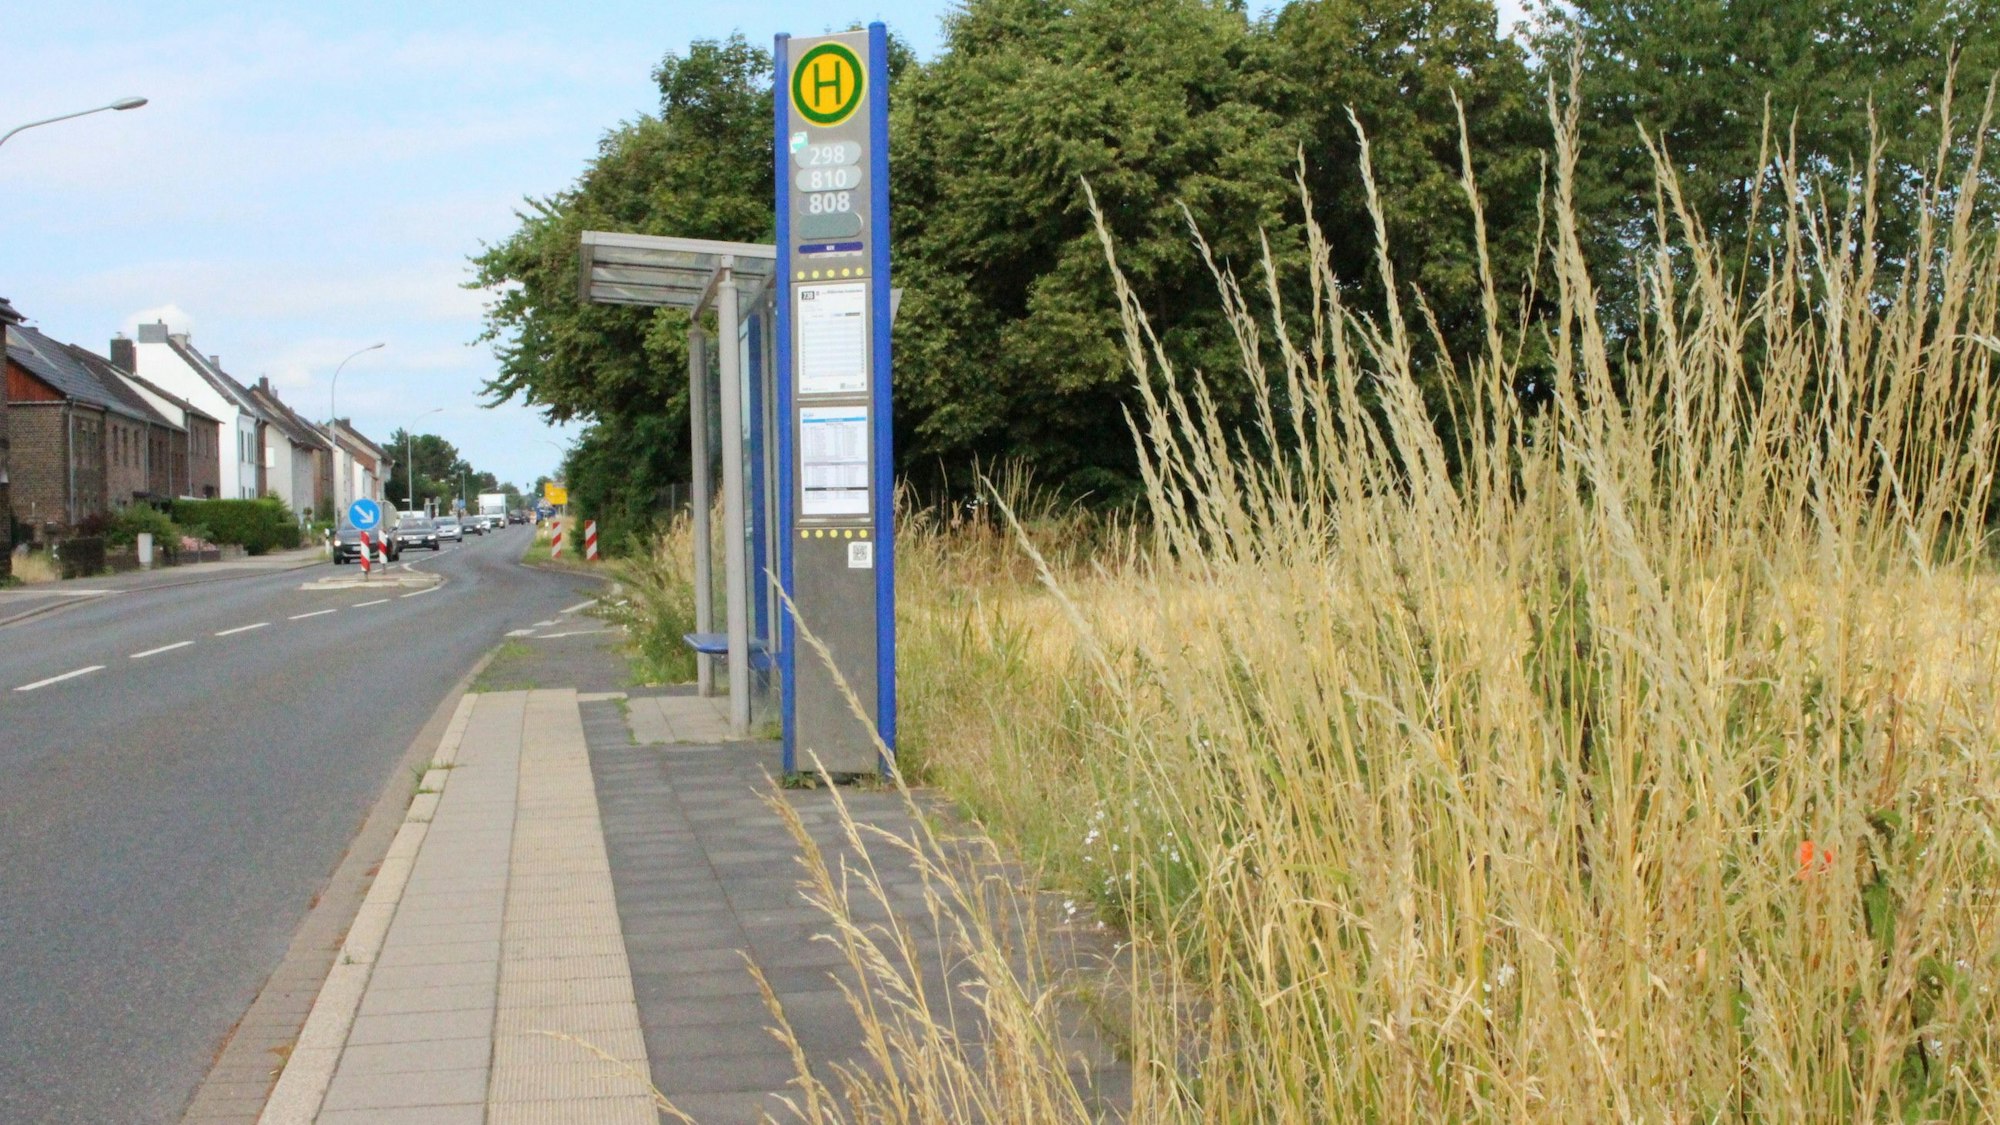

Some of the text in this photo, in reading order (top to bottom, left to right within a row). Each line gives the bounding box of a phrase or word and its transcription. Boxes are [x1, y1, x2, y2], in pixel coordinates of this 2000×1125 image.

[814, 61, 841, 107] H
[810, 145, 845, 165] 298
[811, 169, 847, 189] 810
[810, 191, 850, 214] 808
